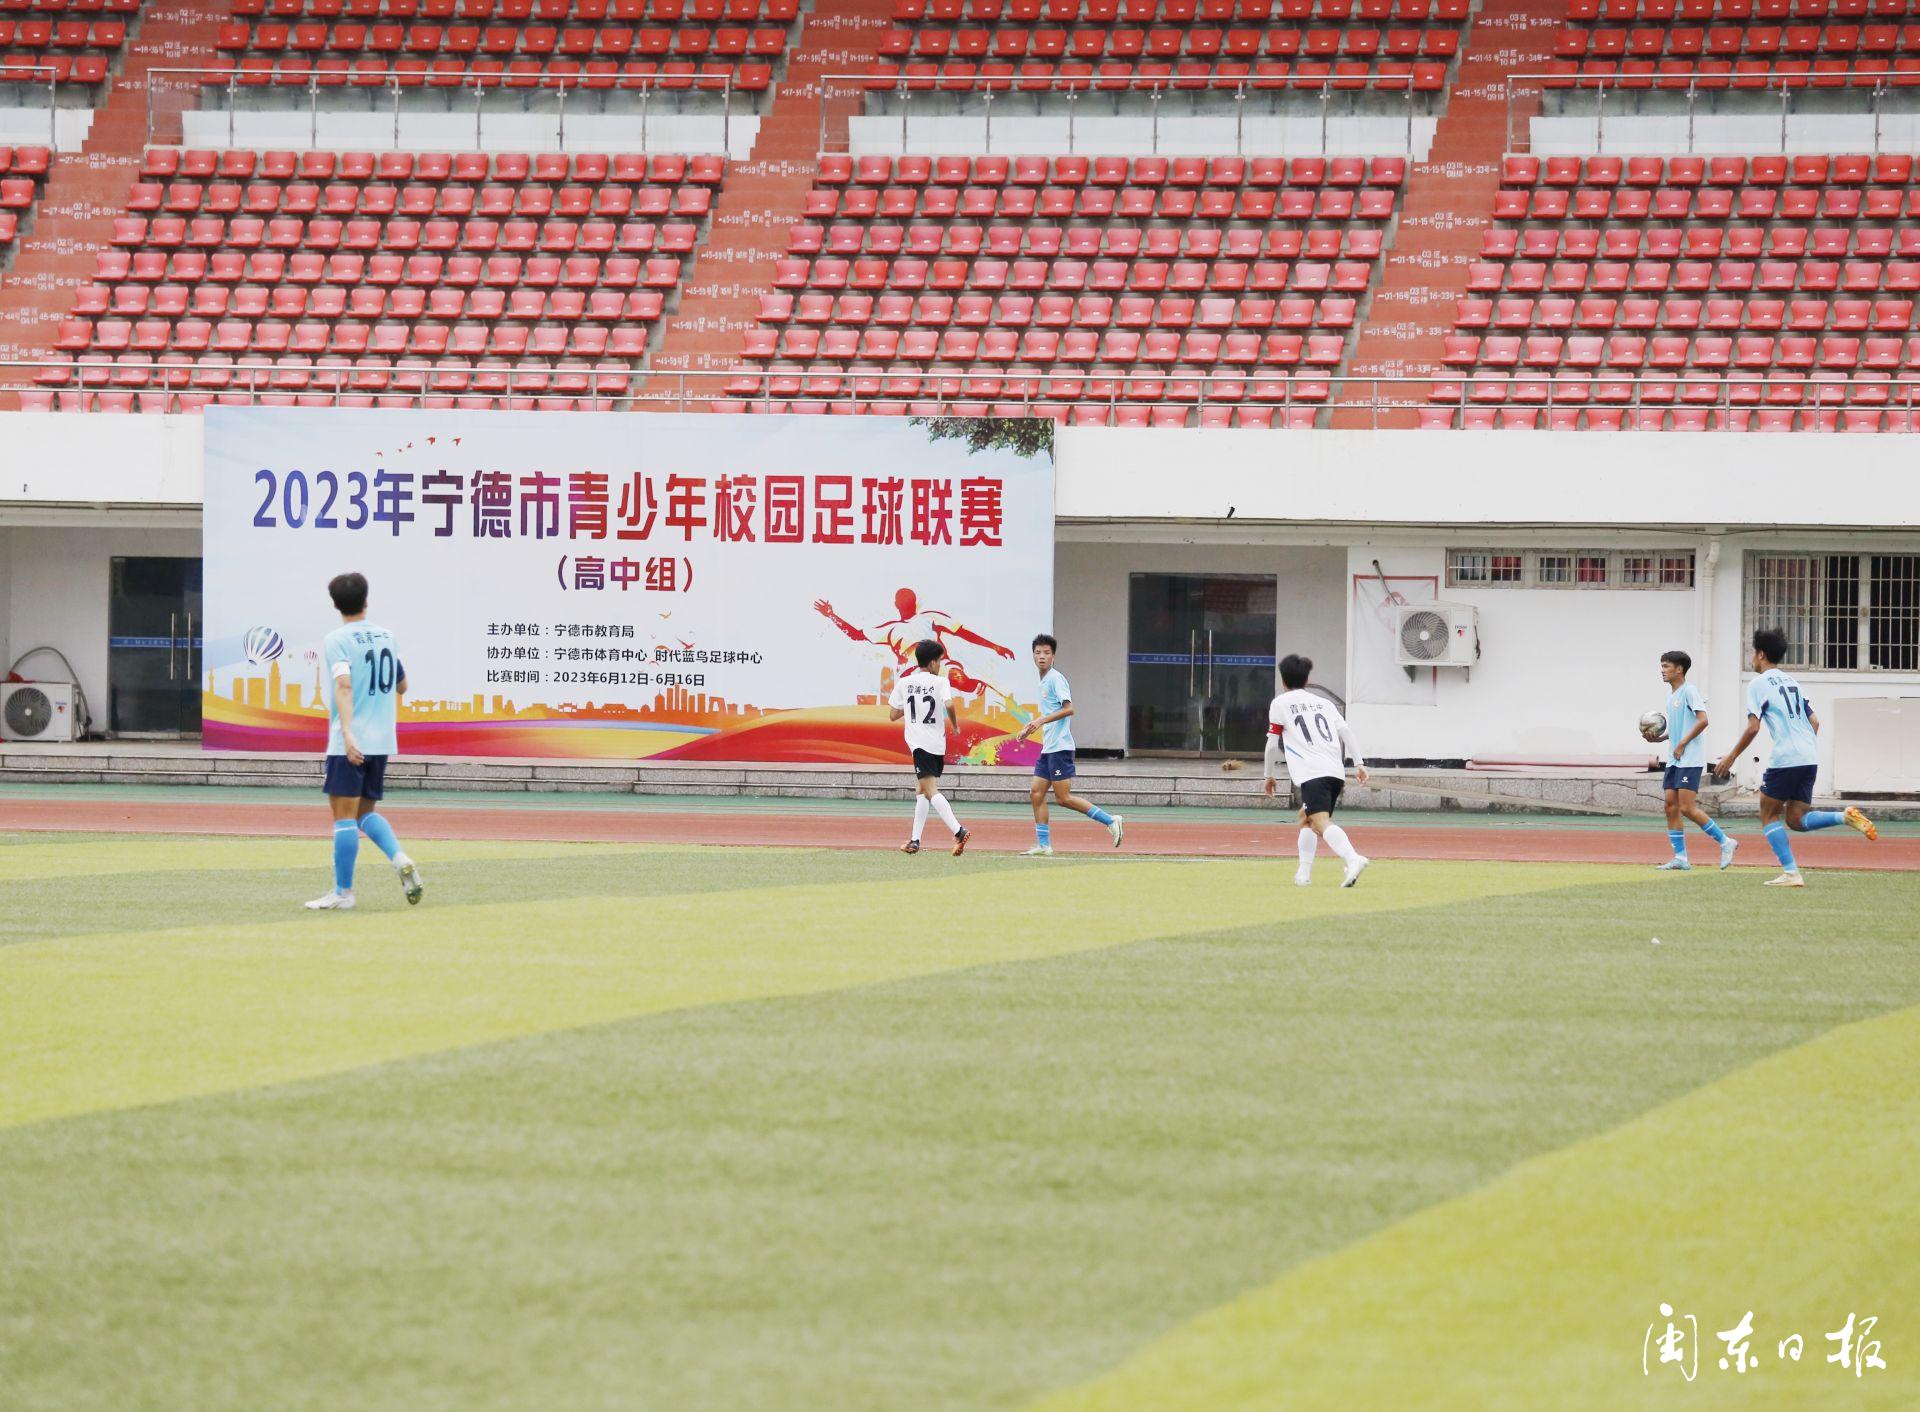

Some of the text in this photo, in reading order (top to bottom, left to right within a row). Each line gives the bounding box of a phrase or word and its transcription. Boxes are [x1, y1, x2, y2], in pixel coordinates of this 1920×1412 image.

[253, 468, 1003, 547] 2023年宁德市青少年校园足球联赛
[487, 623, 634, 638] 主办单位：宁德市教育局
[487, 646, 763, 664] 协办单位：宁德市体育中心 时代蓝鸟足球中心
[365, 648, 394, 696] 10
[487, 669, 705, 687] 比赛时间：2023年6月12日-6月16日
[907, 695, 936, 724] 12
[1779, 686, 1801, 719] 17
[1294, 713, 1333, 746] 10
